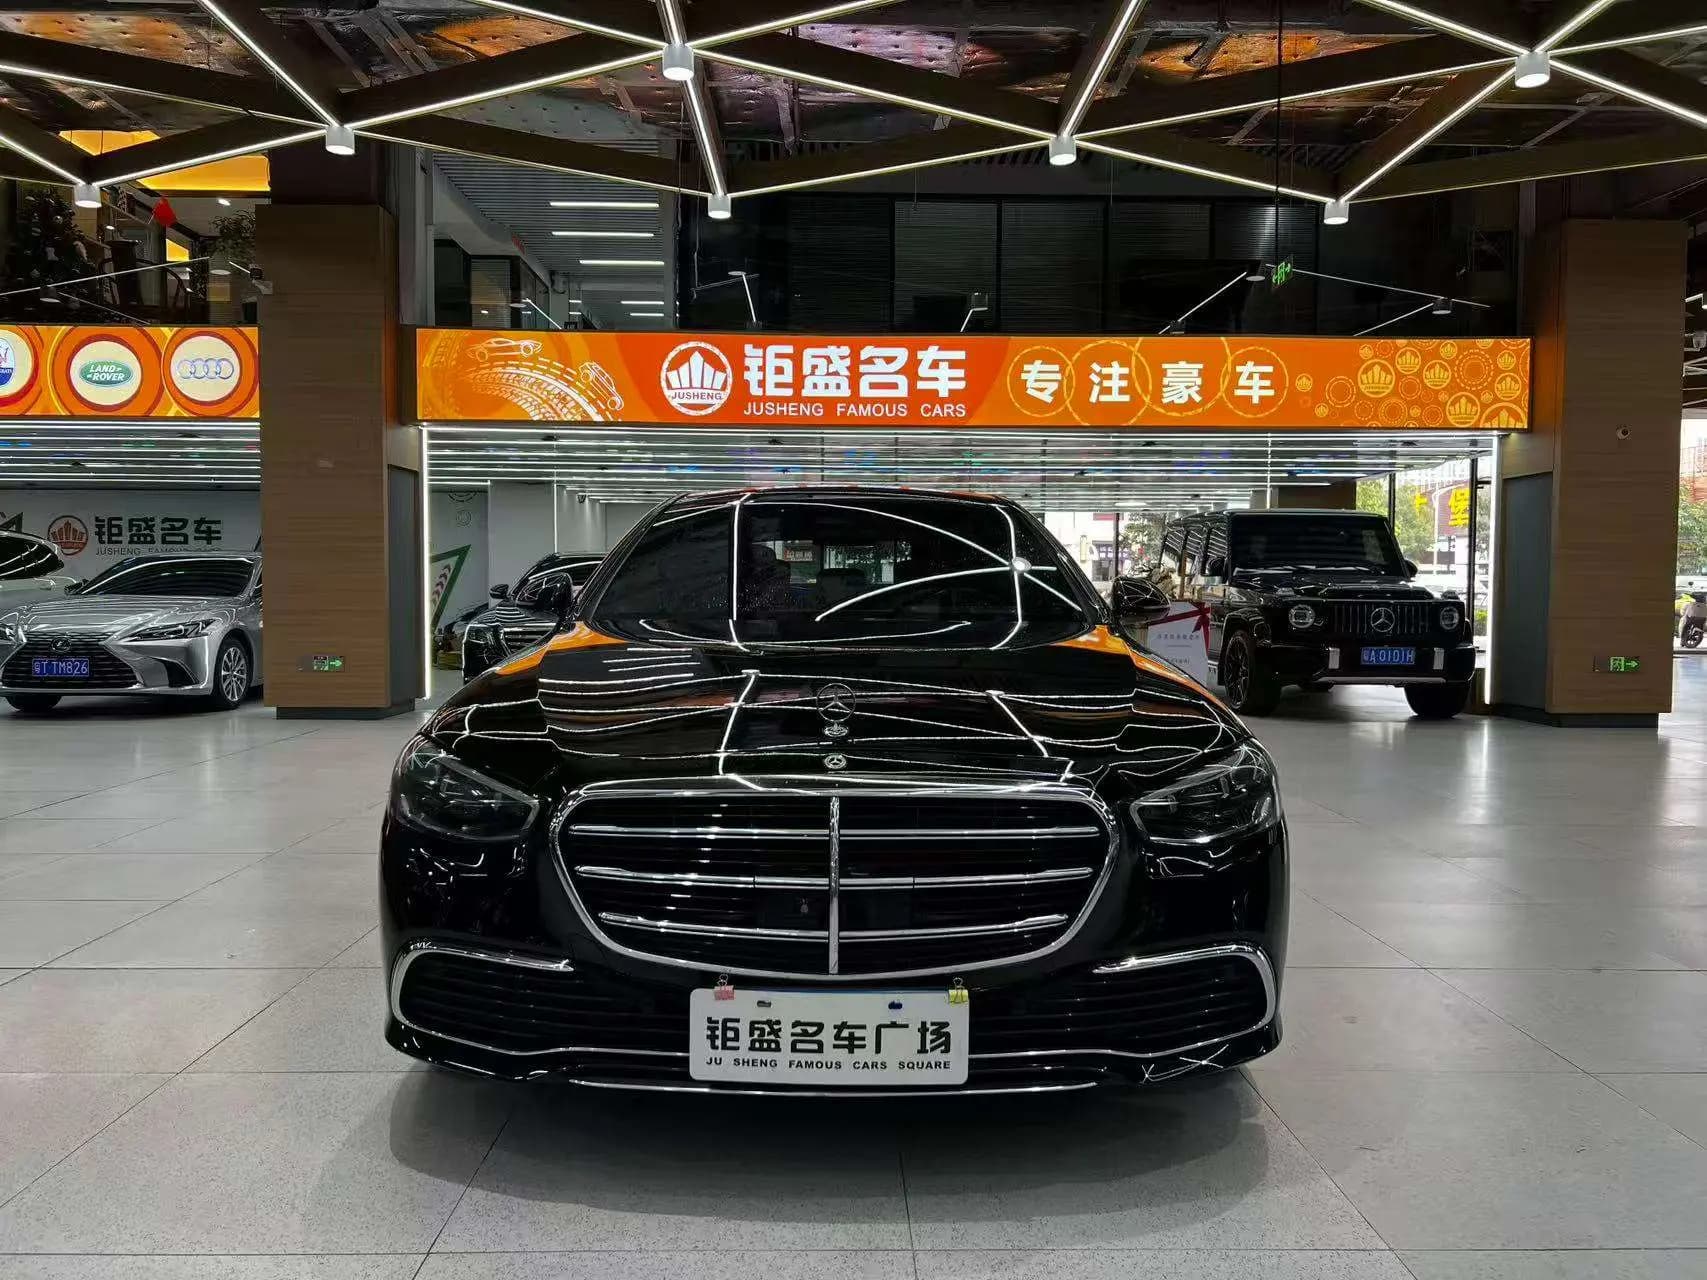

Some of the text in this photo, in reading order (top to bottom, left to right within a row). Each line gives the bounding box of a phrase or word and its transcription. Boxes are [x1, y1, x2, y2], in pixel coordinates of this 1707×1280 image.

[90, 364, 117, 373] LAND
[743, 344, 967, 398] 钜盛名车
[92, 373, 125, 381] ROVER
[1020, 359, 1275, 405] 专注豪车
[671, 391, 722, 400] JUSHENG
[743, 402, 967, 417] JUSHENG FAMOUS CARS
[95, 516, 222, 545] 钜盛名车
[96, 547, 141, 555] JUSHENG
[706, 1016, 952, 1055] 钜盛名车广场
[706, 1057, 951, 1070] JU SHENG FAMOUS CARS SQUARE
